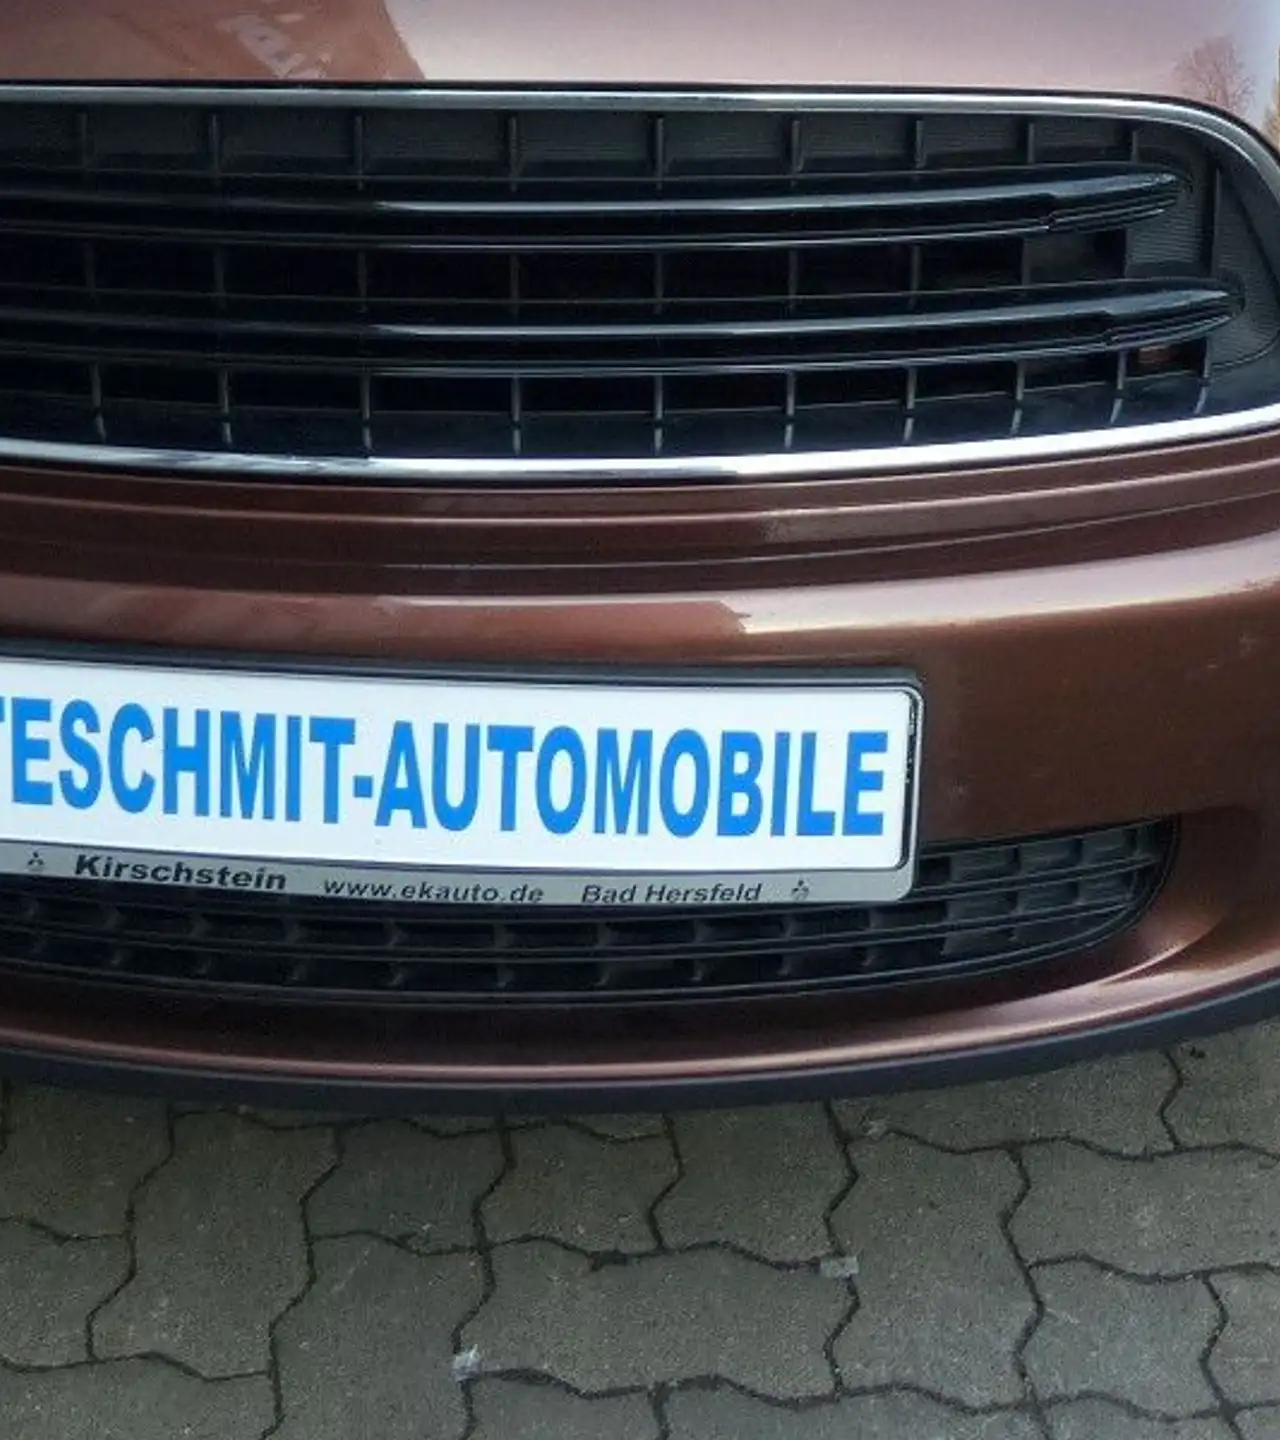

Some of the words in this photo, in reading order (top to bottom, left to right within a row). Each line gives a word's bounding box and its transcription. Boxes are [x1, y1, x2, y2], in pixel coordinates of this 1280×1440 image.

[75, 855, 287, 891] Kirschstein
[323, 878, 544, 904] www.ekauto.de
[581, 883, 636, 903] Bad
[644, 883, 763, 903] Hersfeld
